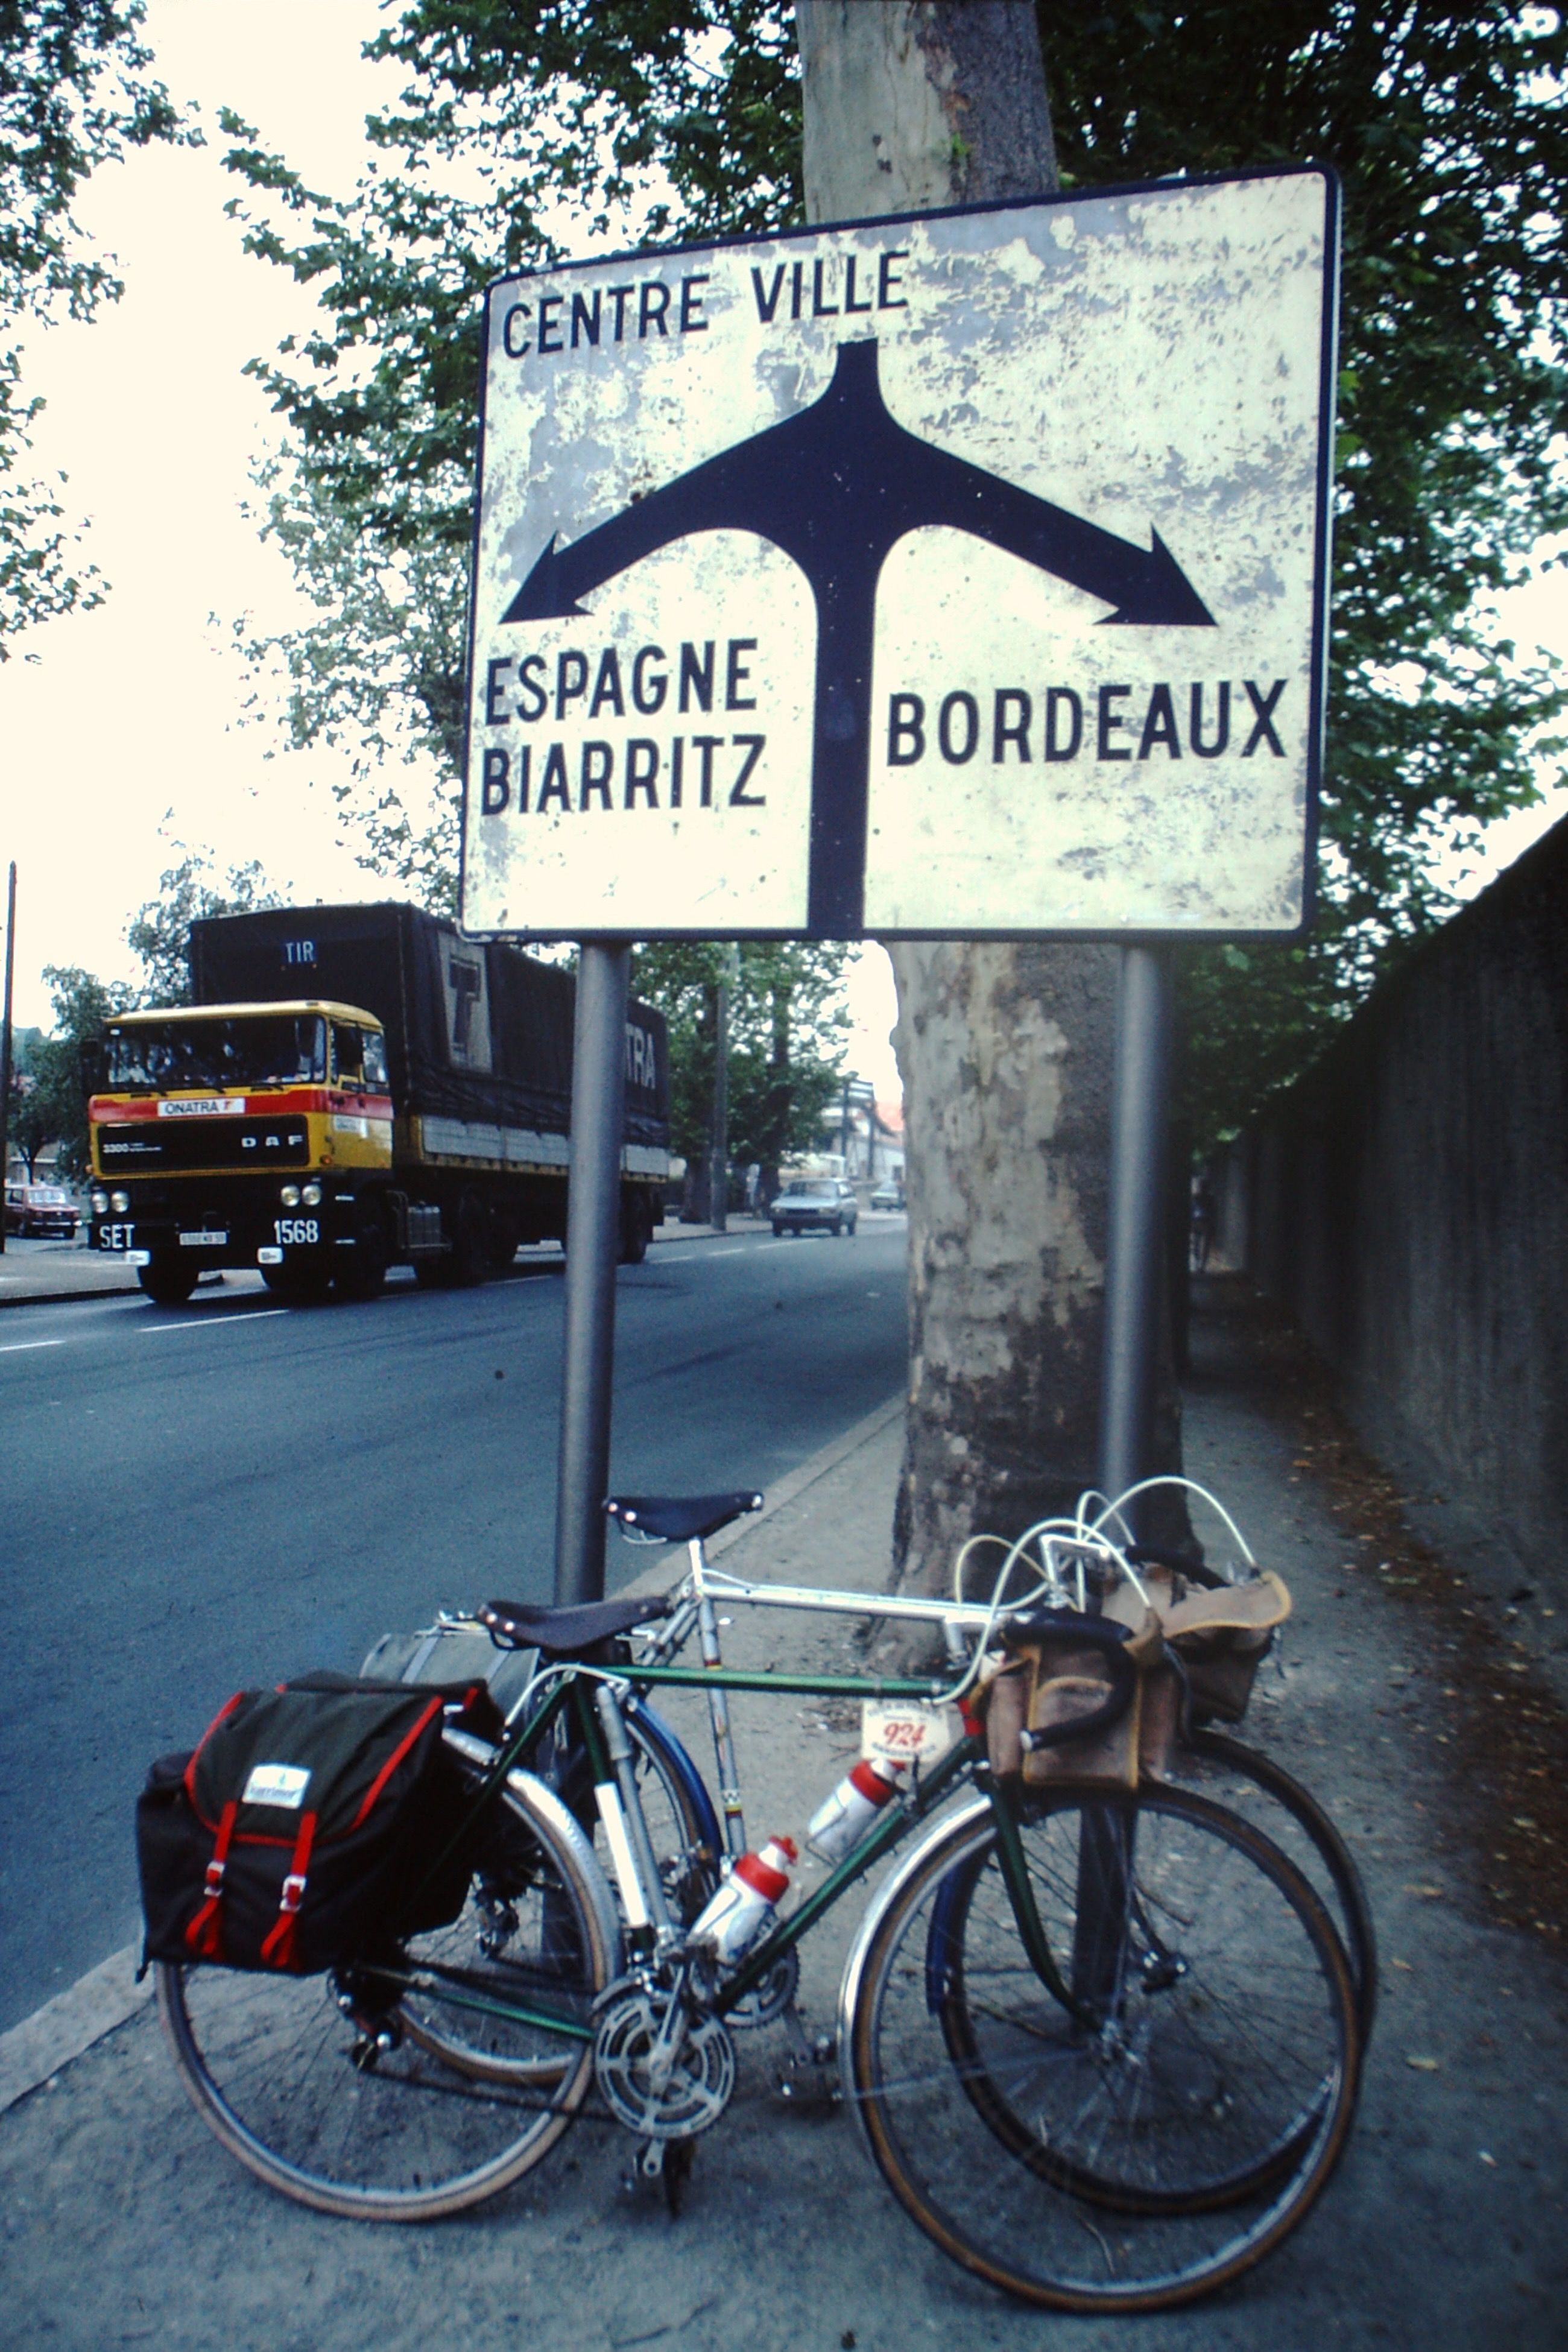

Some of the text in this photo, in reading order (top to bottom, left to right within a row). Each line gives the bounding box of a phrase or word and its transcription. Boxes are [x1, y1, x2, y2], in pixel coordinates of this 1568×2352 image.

[504, 251, 909, 358] CENTRE VILLE
[485, 638, 757, 726] ESPAGNE
[887, 678, 1288, 767] BORDEAUX
[481, 734, 766, 815] BIARRITZ
[285, 941, 314, 963] TIR
[165, 1101, 219, 1114] ONATRA
[99, 1224, 135, 1248] SET
[274, 1219, 318, 1244] 1568
[884, 1722, 926, 1748] 924
